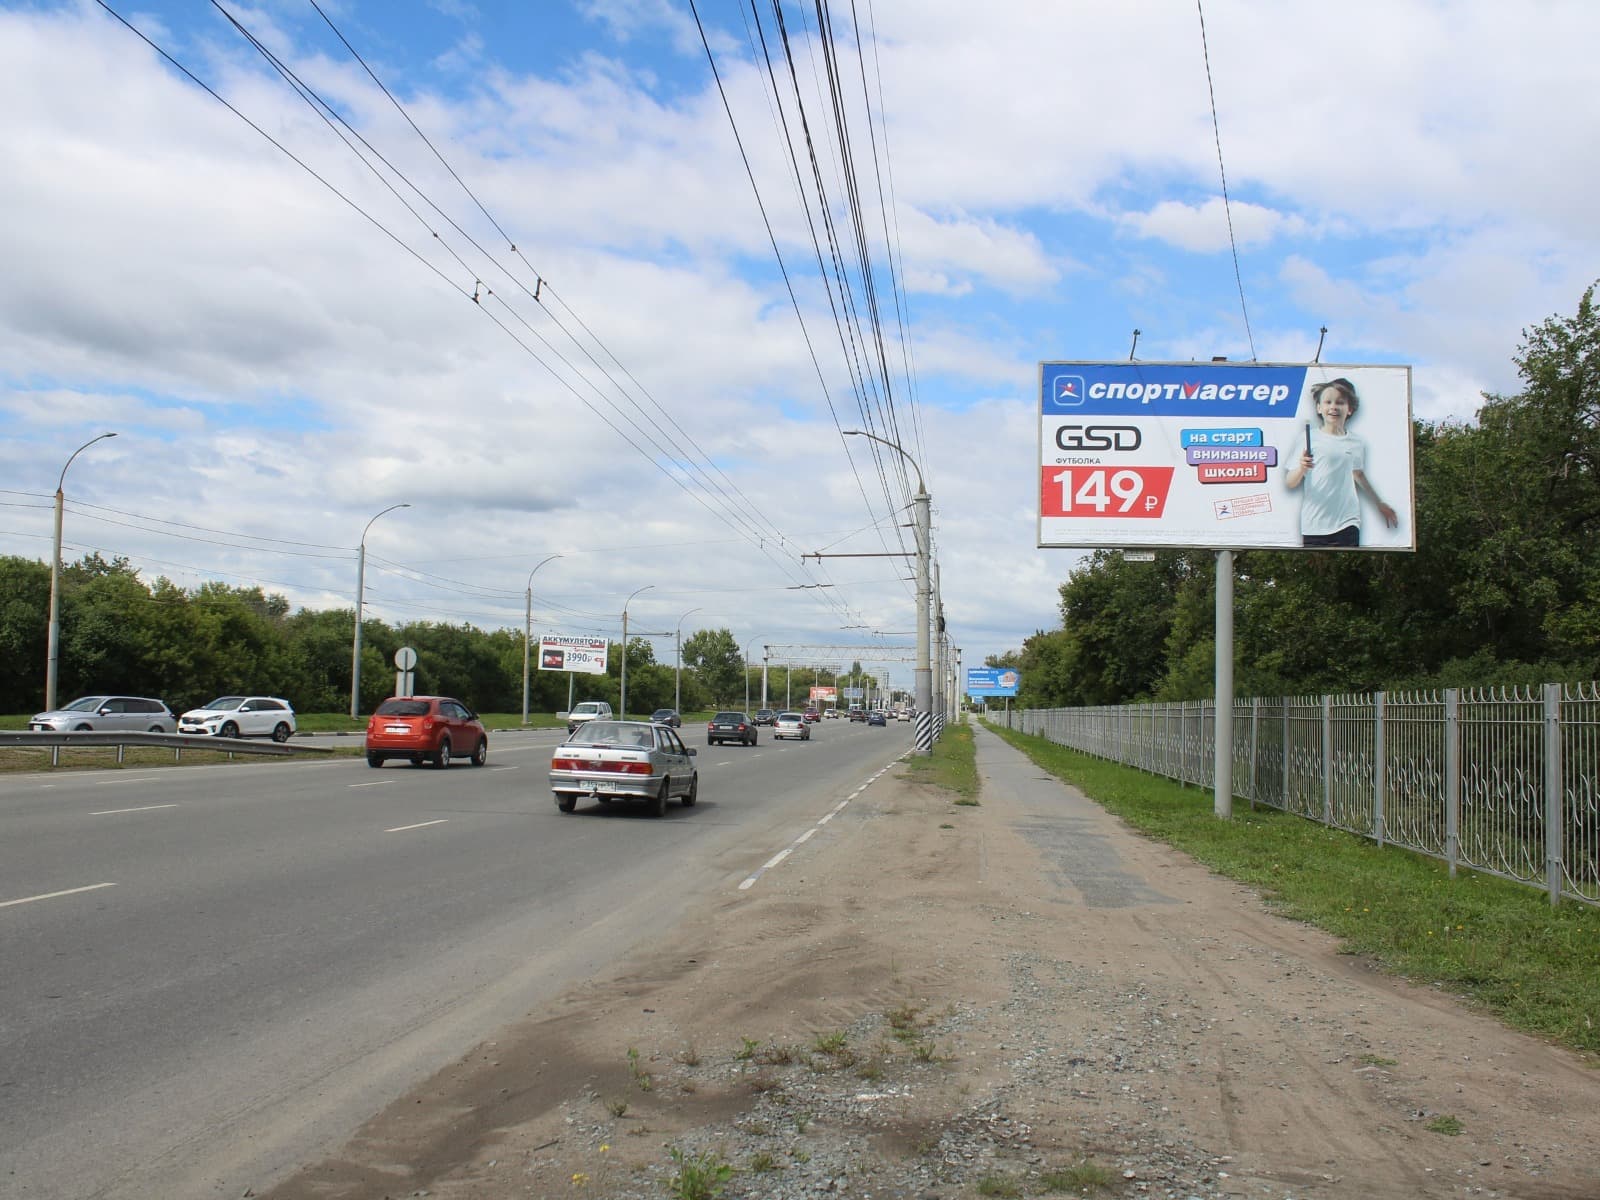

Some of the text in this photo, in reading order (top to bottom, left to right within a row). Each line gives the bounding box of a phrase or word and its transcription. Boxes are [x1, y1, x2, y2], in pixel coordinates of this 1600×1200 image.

[1088, 380, 1289, 406] спортмастер
[1055, 425, 1142, 451] GSD
[1190, 431, 1253, 444] на старт
[1055, 456, 1101, 465] ФУТБОЛКА
[1193, 449, 1267, 461] внимание
[1204, 465, 1258, 478] школа!
[543, 636, 605, 645] АККУМУЛЯТОРЫ
